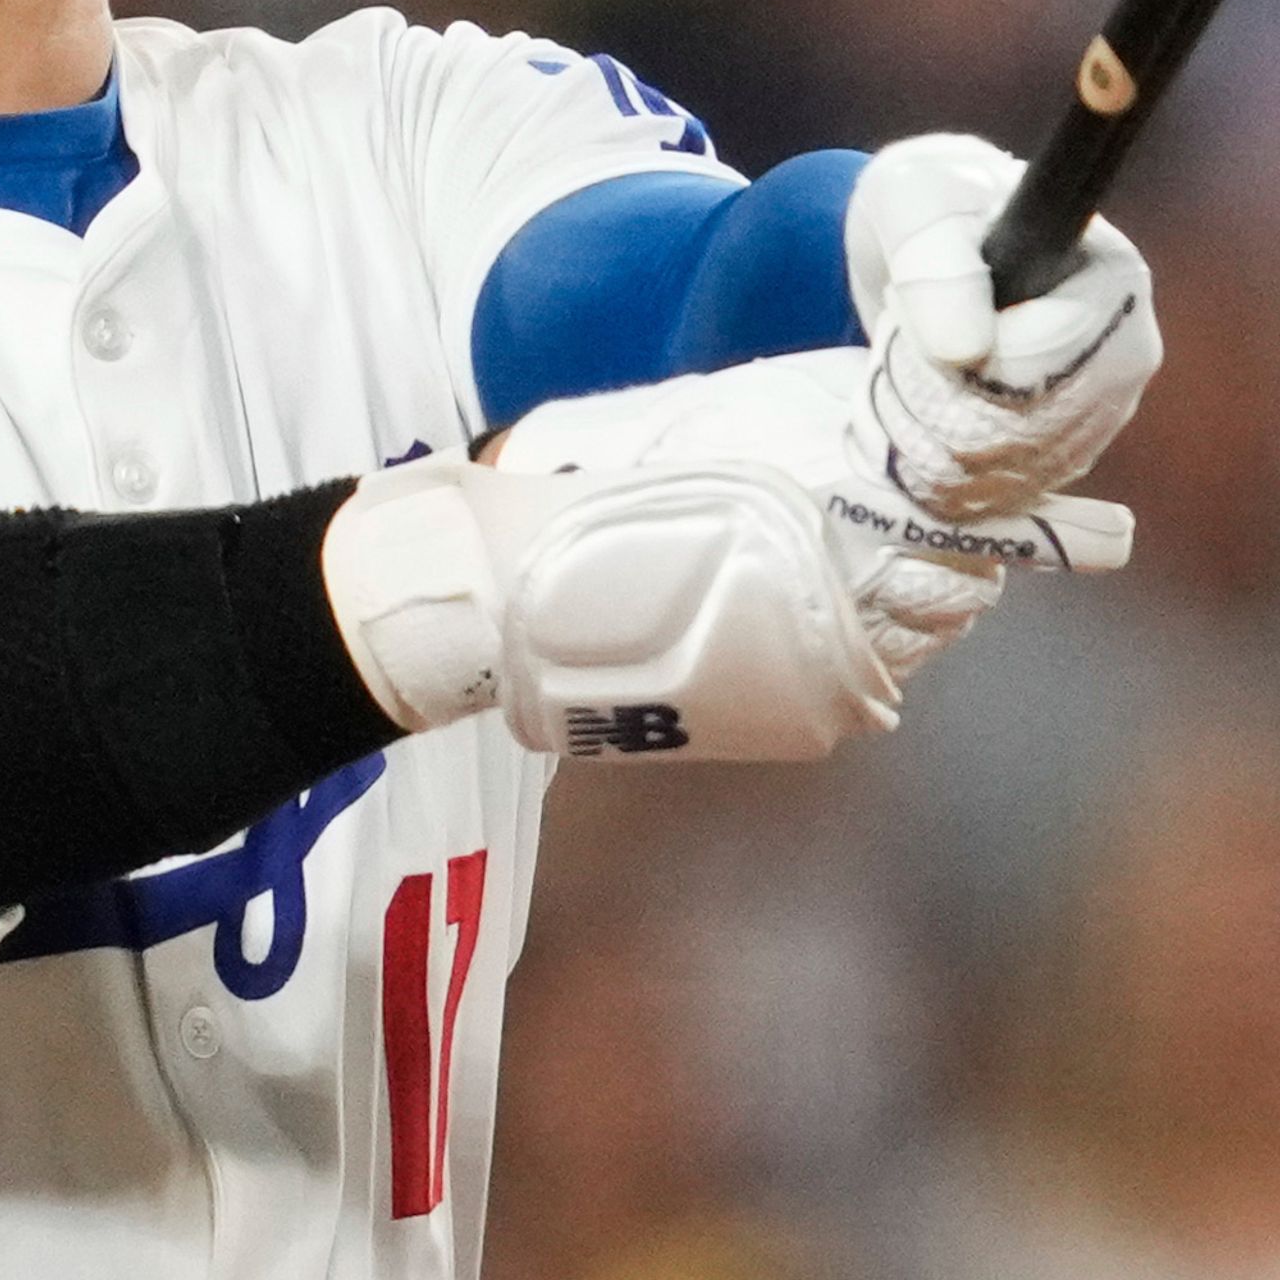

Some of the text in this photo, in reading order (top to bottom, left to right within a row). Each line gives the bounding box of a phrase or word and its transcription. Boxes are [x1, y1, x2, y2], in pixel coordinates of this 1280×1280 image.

[827, 494, 1038, 560] new balance
[383, 847, 488, 1220] 17
